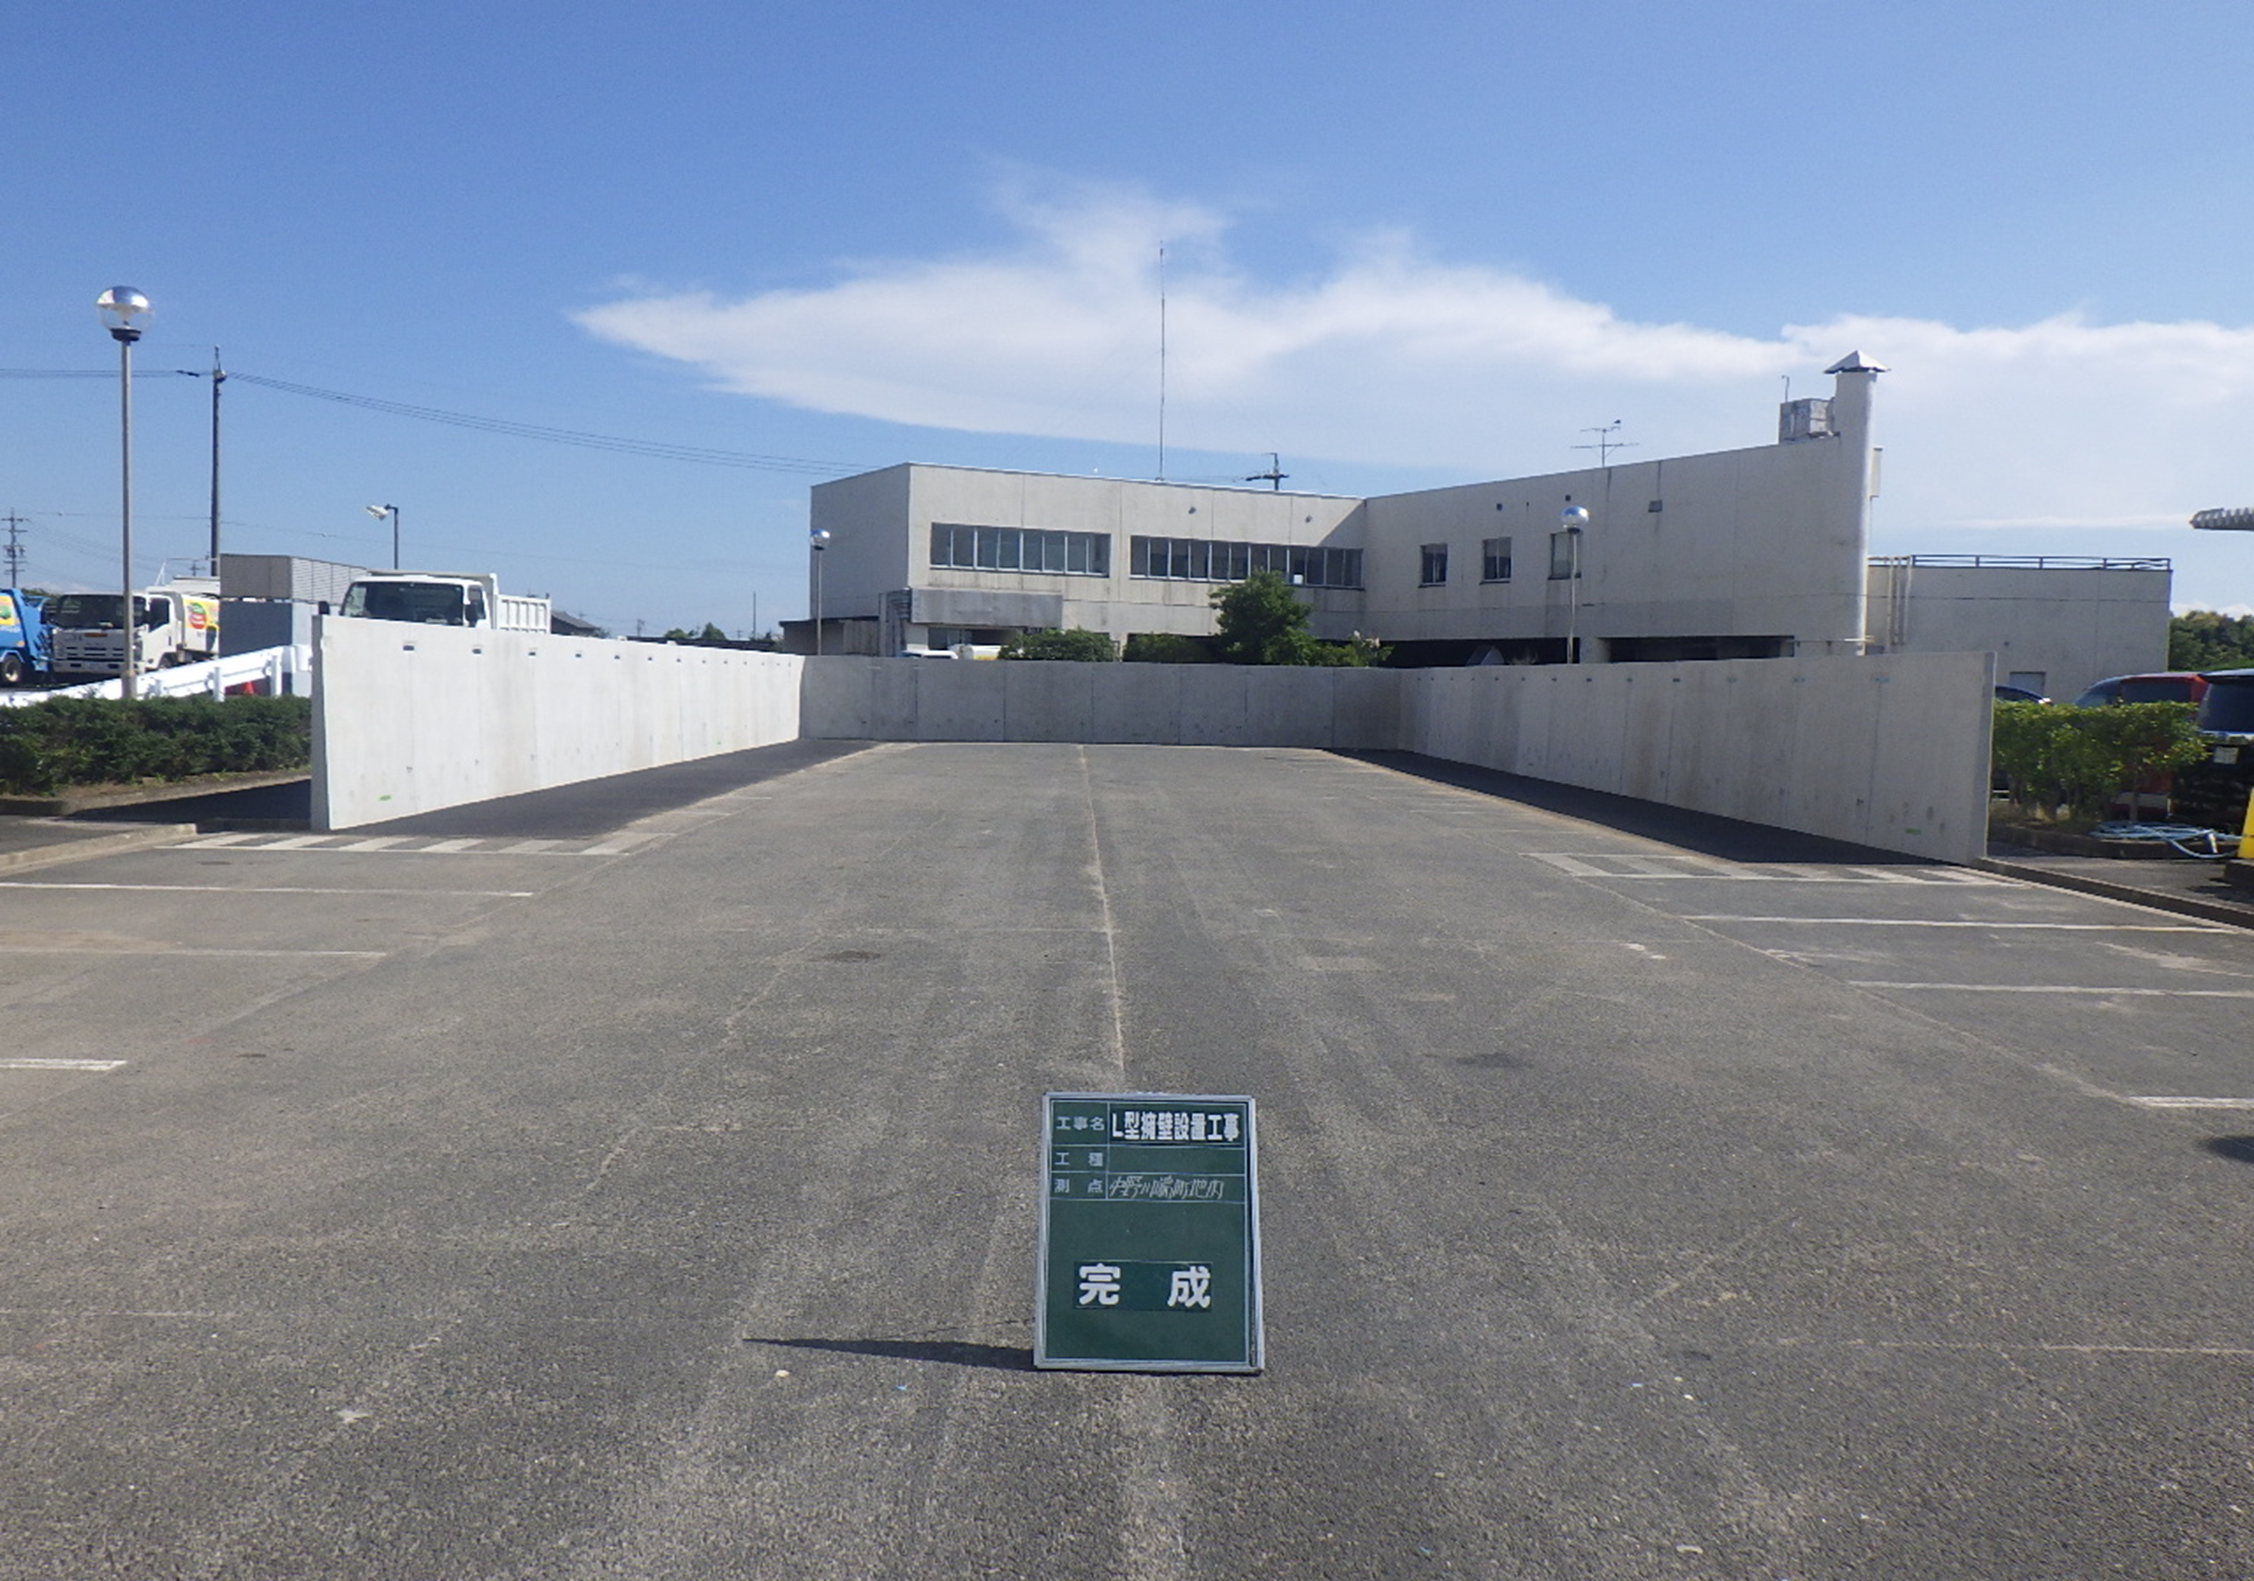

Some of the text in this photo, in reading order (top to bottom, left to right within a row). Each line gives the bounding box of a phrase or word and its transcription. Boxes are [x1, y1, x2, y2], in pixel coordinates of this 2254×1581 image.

[1056, 1116, 1105, 1131] 工事名
[1112, 1111, 1240, 1142] L型擁壁設置工事
